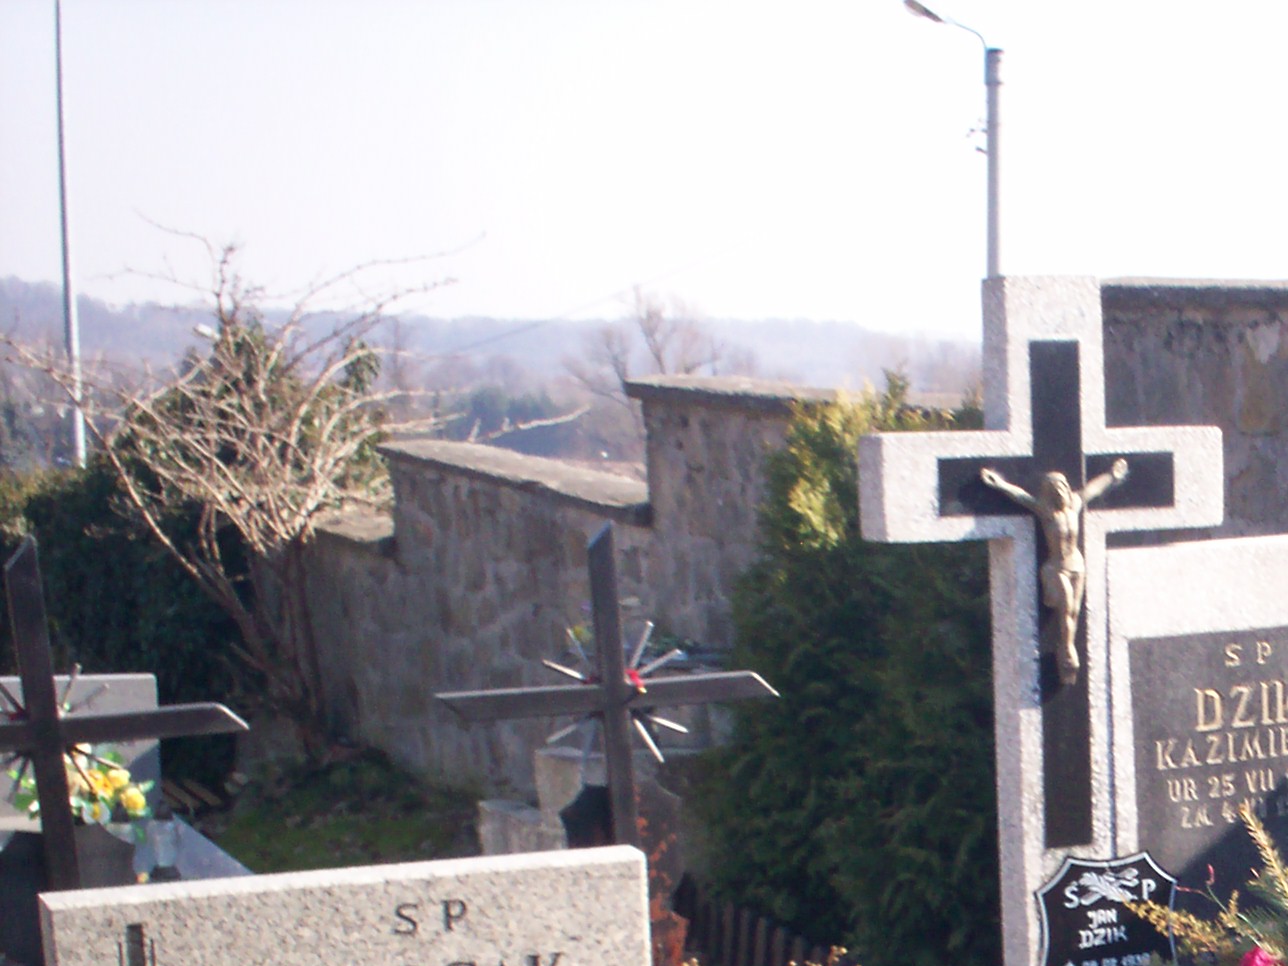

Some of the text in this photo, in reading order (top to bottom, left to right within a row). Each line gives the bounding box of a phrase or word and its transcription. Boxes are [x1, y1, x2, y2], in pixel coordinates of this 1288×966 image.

[1256, 641, 1272, 664] P
[1167, 779, 1199, 802] UR
[1208, 774, 1236, 798] 25
[1245, 768, 1275, 793] VII
[1142, 879, 1156, 900] P
[442, 899, 467, 932] P
[1087, 908, 1117, 929] JAN
[1079, 925, 1127, 949] DZIK
